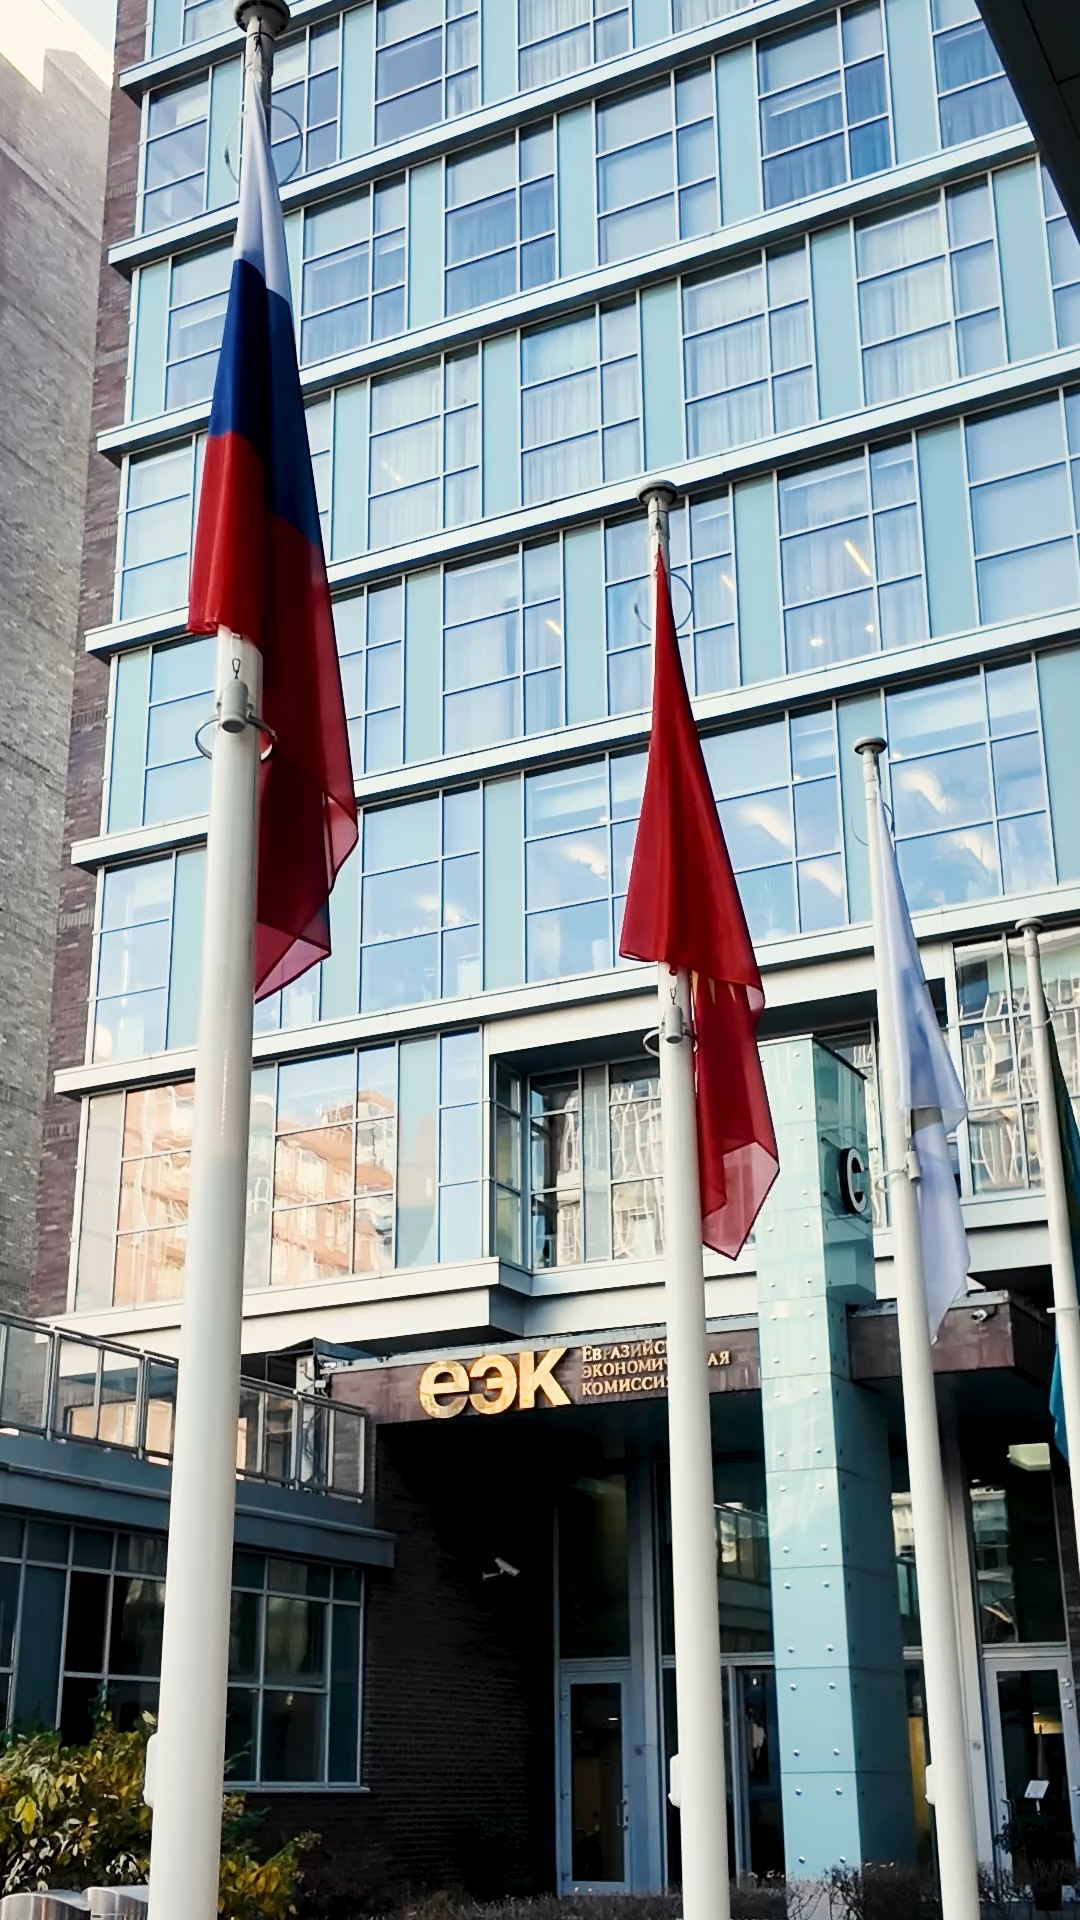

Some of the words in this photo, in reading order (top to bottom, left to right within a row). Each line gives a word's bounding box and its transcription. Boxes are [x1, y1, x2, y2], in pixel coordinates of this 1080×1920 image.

[581, 1339, 667, 1362] ЕВРАЗИЙС
[581, 1350, 730, 1379] ЭКОНОМИАЯ
[581, 1375, 668, 1396] КОМИССИ
